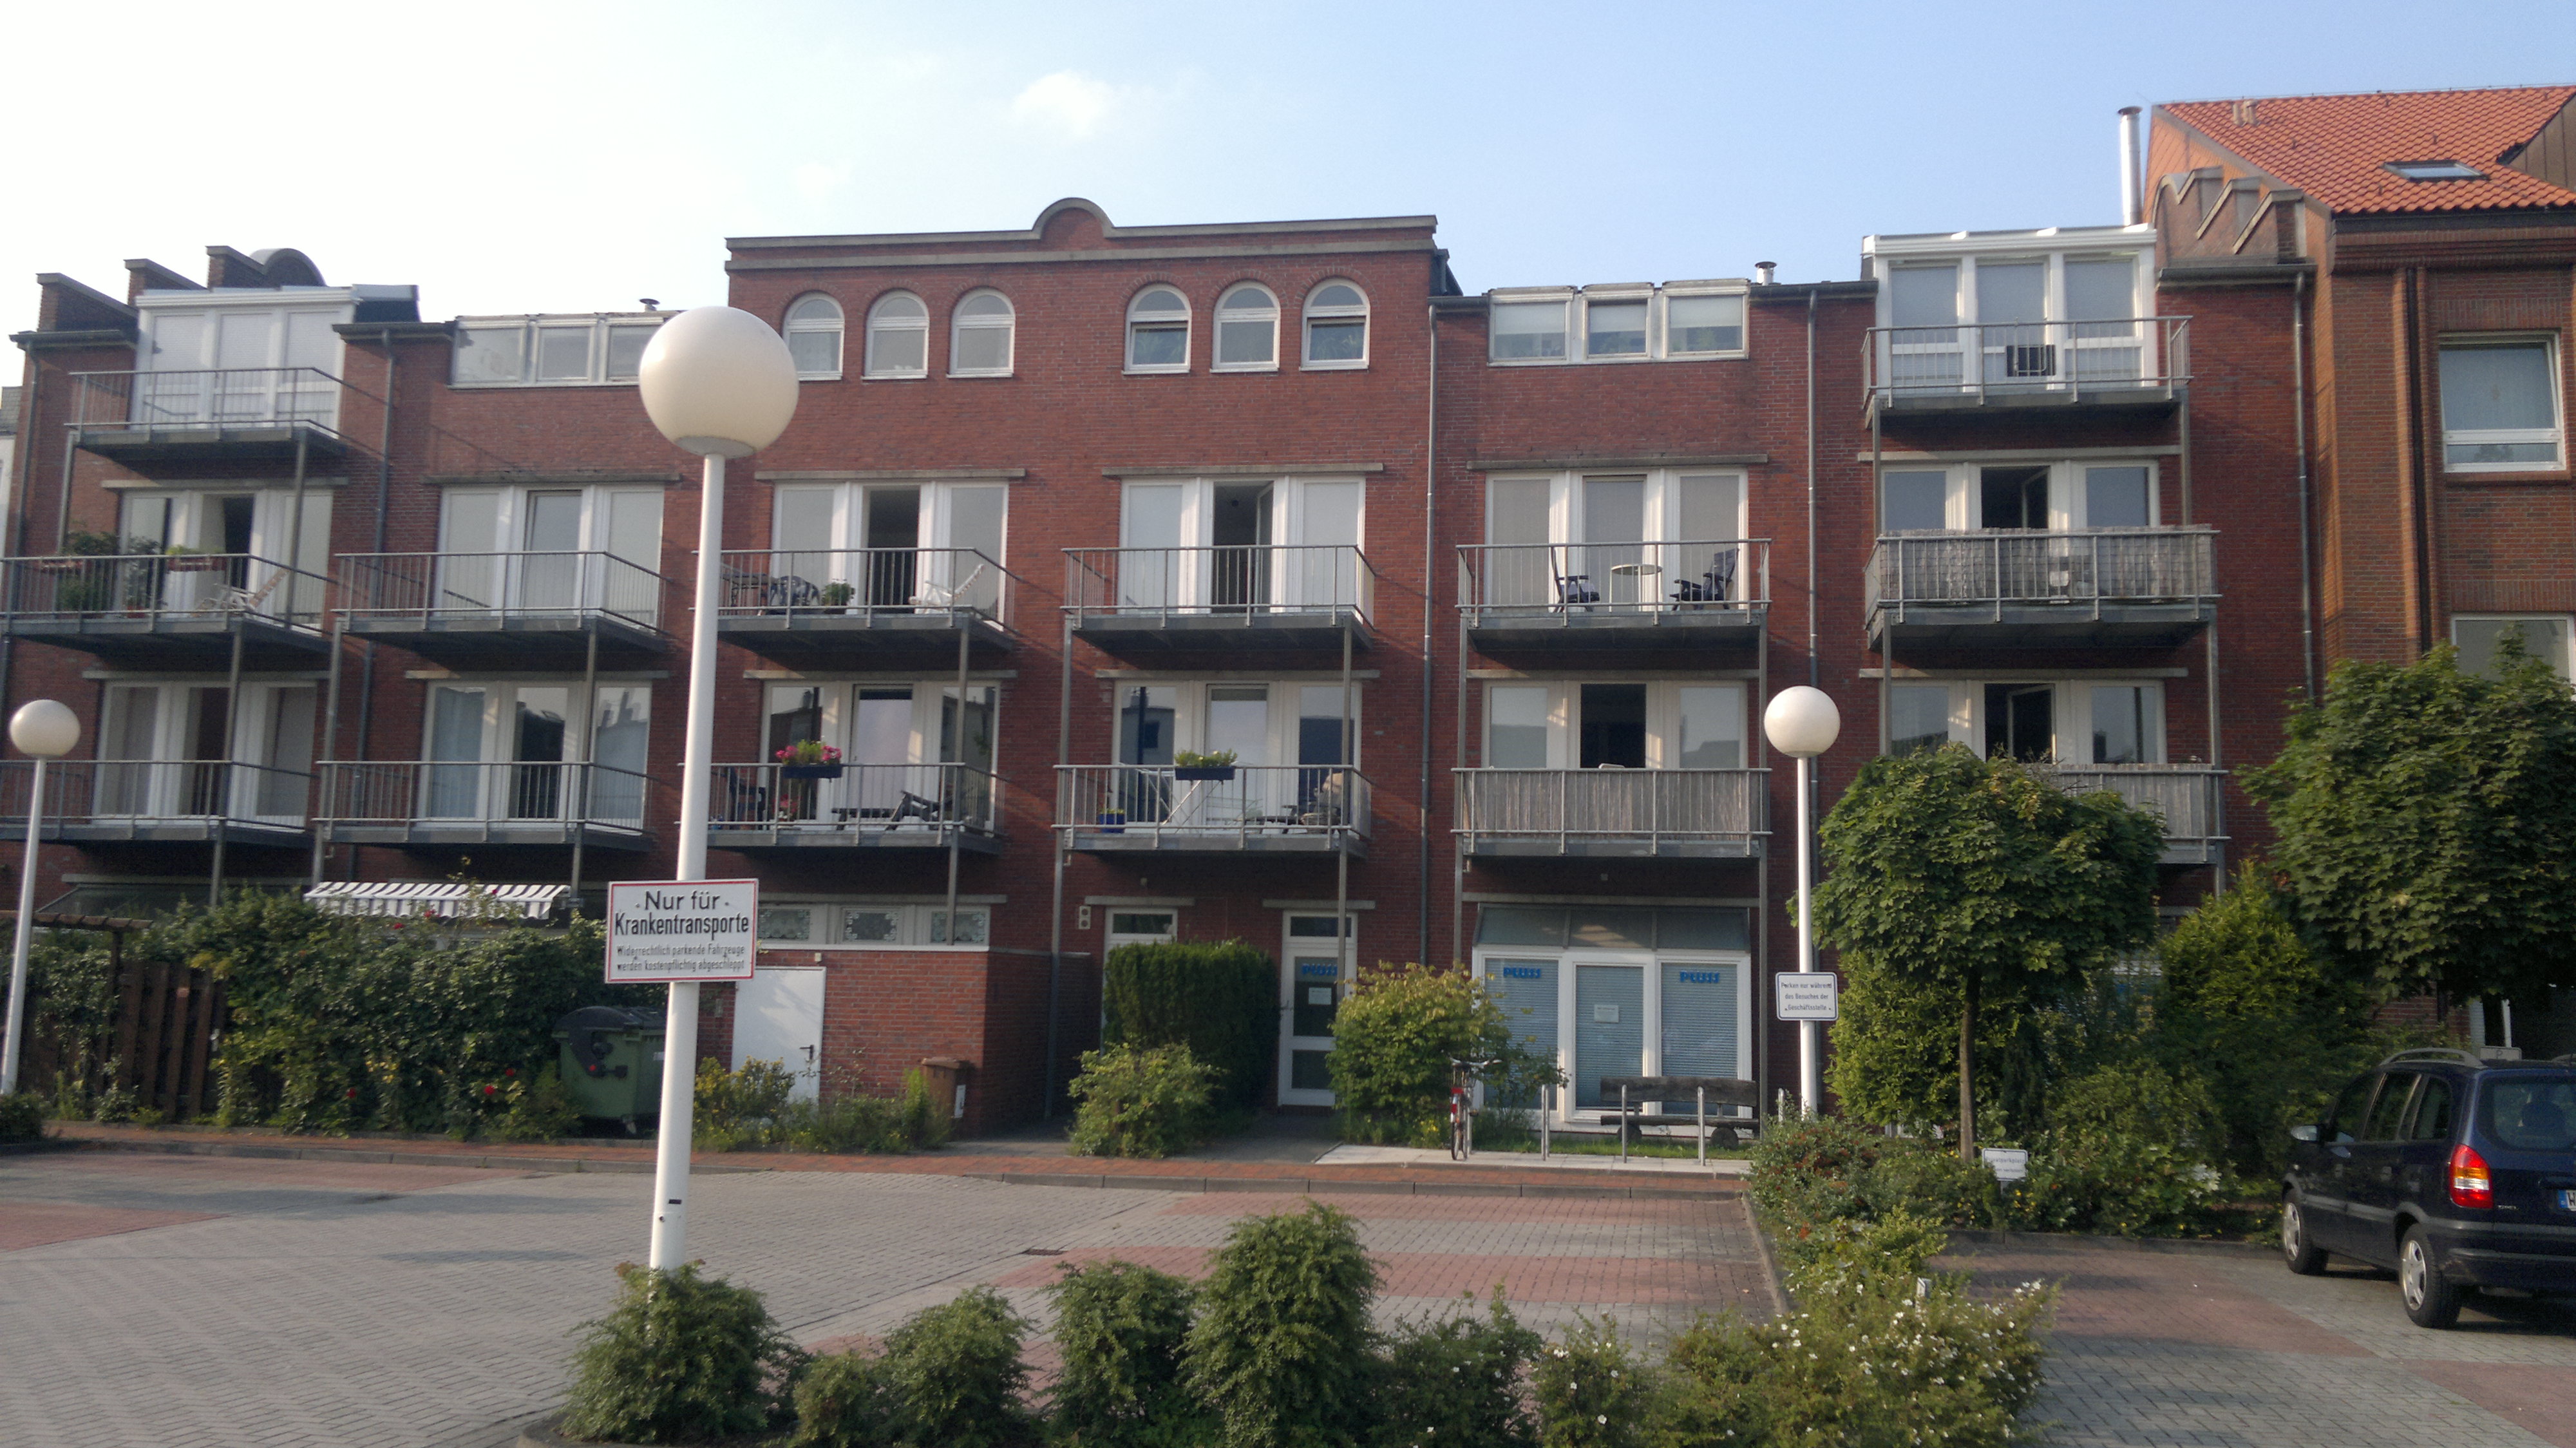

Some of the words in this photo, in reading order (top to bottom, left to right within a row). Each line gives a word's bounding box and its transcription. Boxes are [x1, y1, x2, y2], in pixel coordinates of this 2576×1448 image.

[645, 890, 685, 910] Nur
[691, 890, 721, 910] für
[615, 912, 749, 940] Krankentransporte
[617, 944, 671, 956] Widerrechtlich
[672, 944, 706, 957] parkende
[708, 943, 745, 957] Fahrzeuge
[617, 960, 642, 971] werden
[645, 958, 696, 973] kostenpflichtig
[698, 958, 744, 972] abgeschleppt
